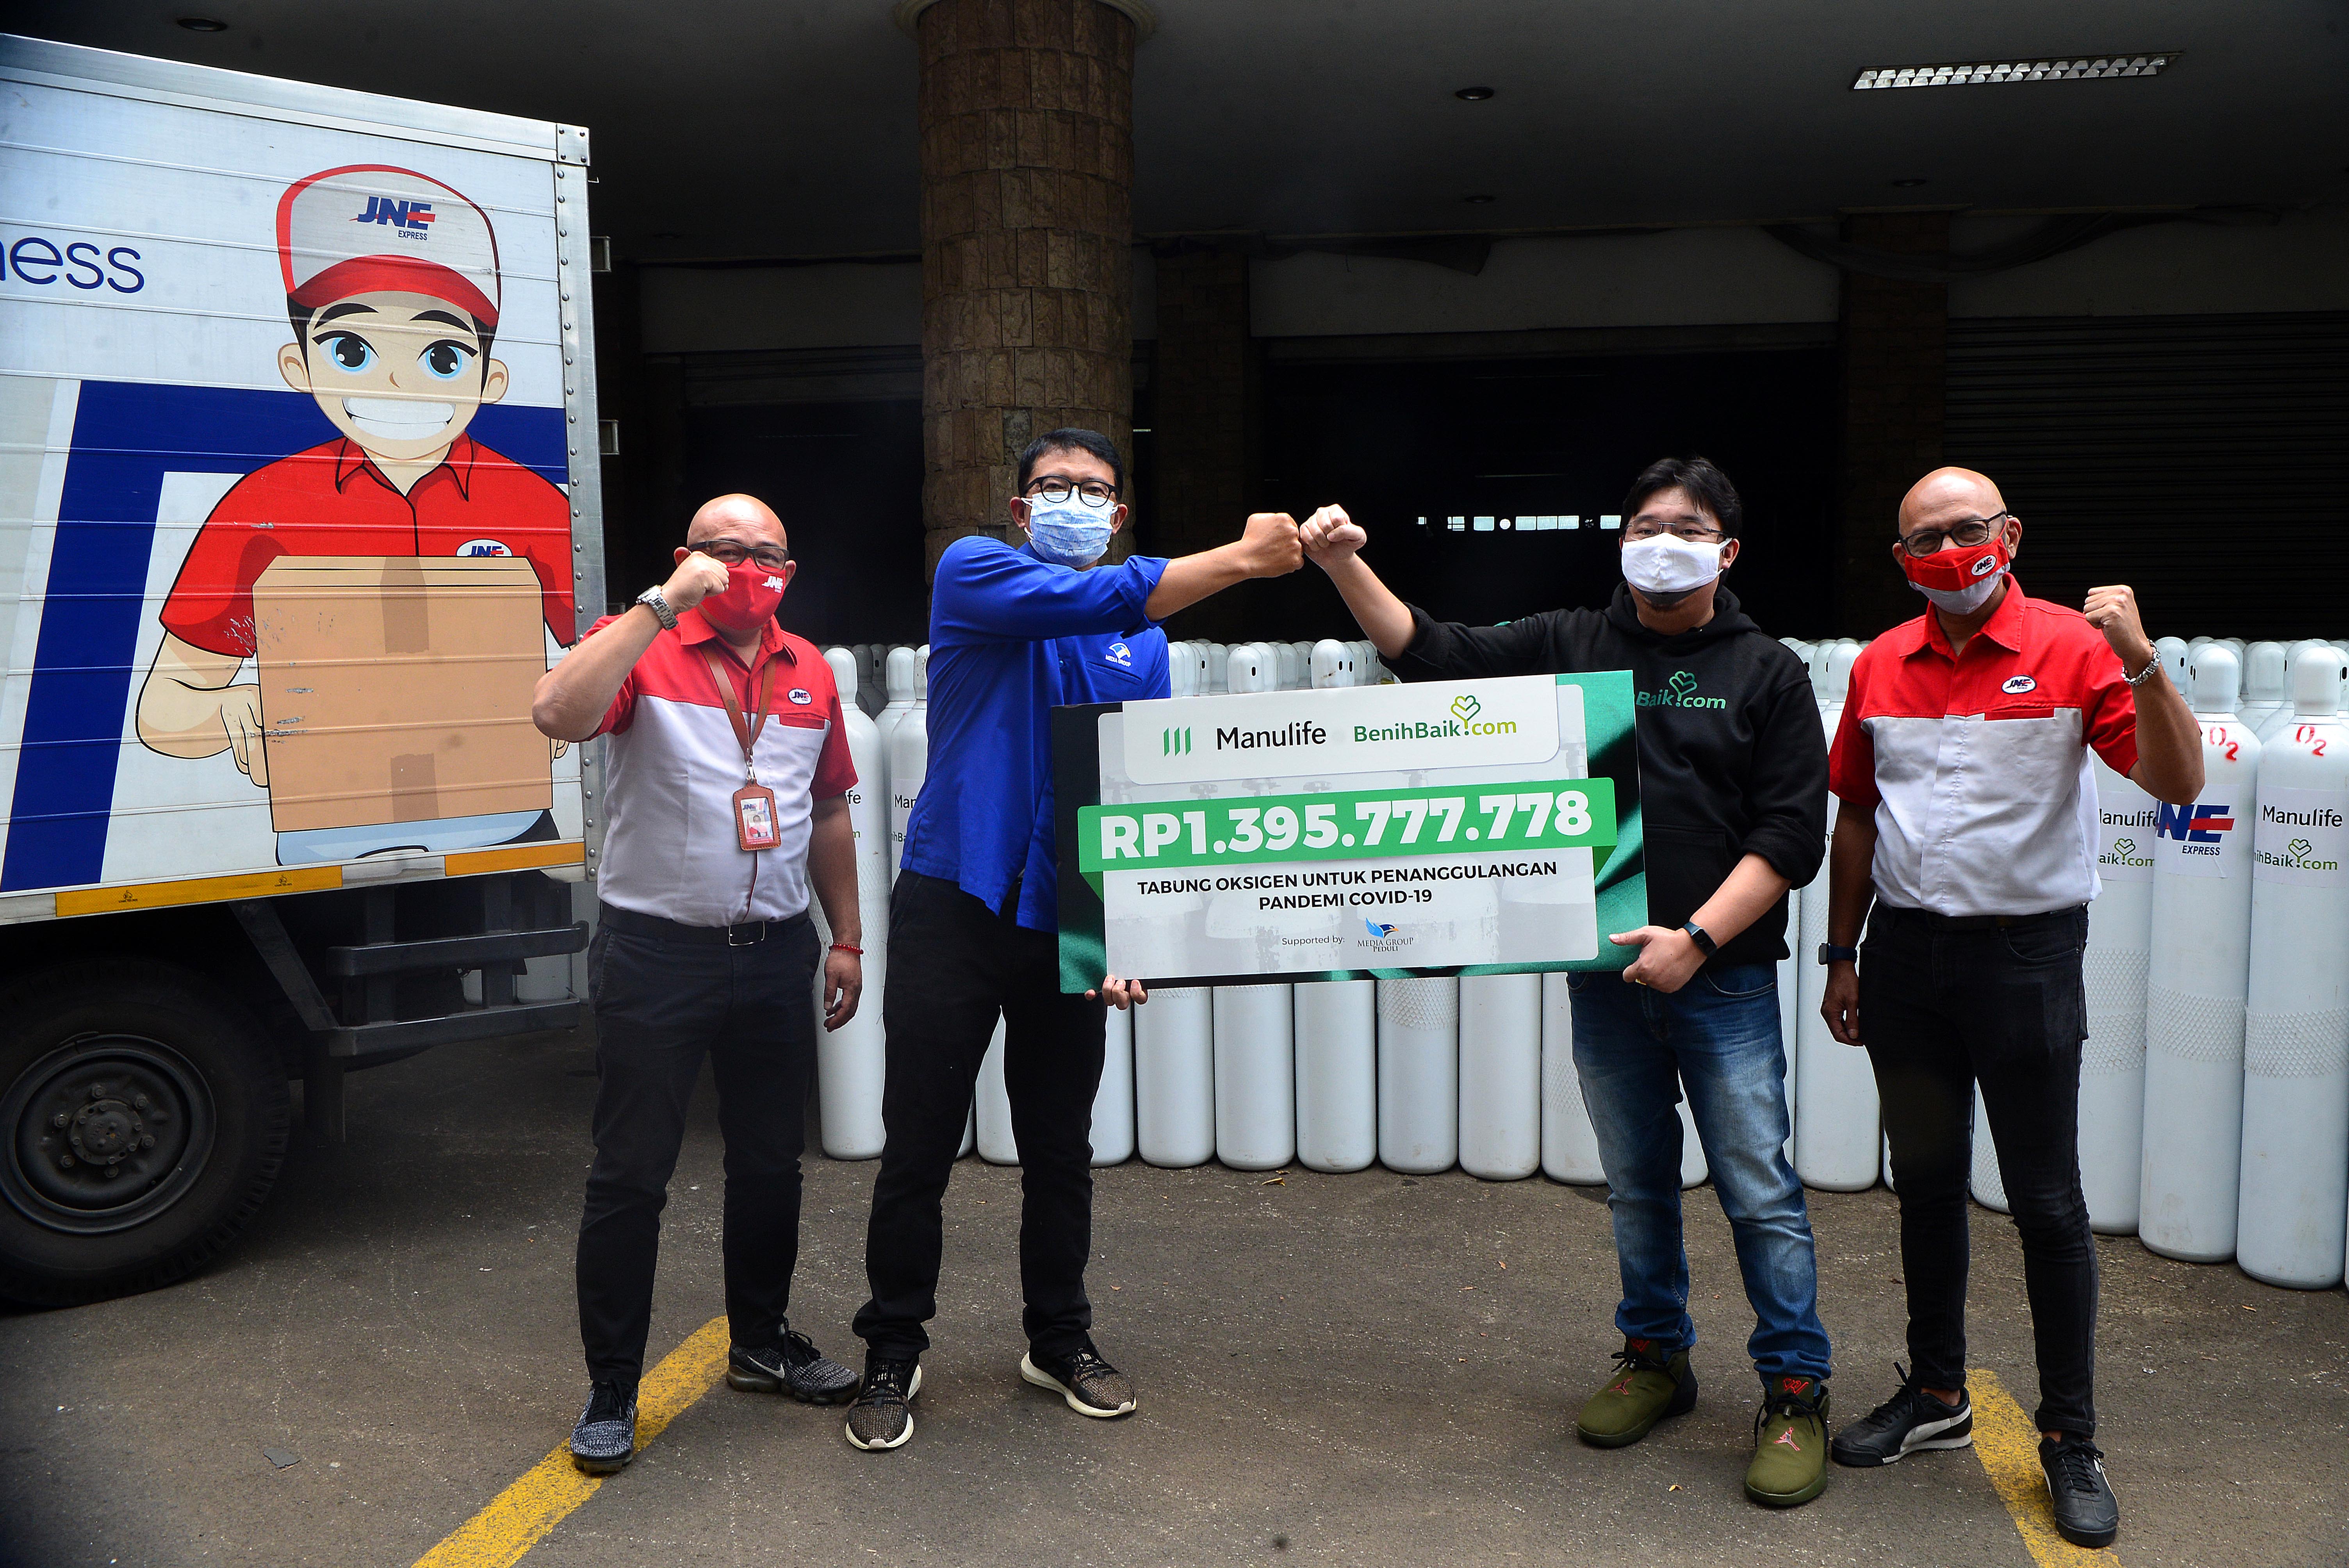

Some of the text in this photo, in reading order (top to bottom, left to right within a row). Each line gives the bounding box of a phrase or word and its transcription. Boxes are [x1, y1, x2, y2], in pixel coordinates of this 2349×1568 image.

[349, 196, 436, 230] JNE
[398, 230, 428, 241] EXPRESS
[1975, 557, 1992, 572] JNE
[761, 576, 783, 590] JNE
[2005, 679, 2032, 688] JNE
[1635, 686, 1726, 709] Baik.com
[1217, 721, 1327, 750] Manulife
[1100, 790, 1593, 859] RP1.395.777.778
[2099, 808, 2157, 827] anulif
[2156, 802, 2235, 843] NE
[2263, 804, 2343, 827] Manulife
[2182, 845, 2221, 856] EXPRESS
[1137, 861, 1557, 895] TABUNG OKSIGEN UNTUK PENANGGULANGAN
[1259, 889, 1432, 910] PANDEMI COVID-19
[1281, 935, 1345, 947] Supported by:
[1357, 937, 1414, 947] MEDIA GROUP
